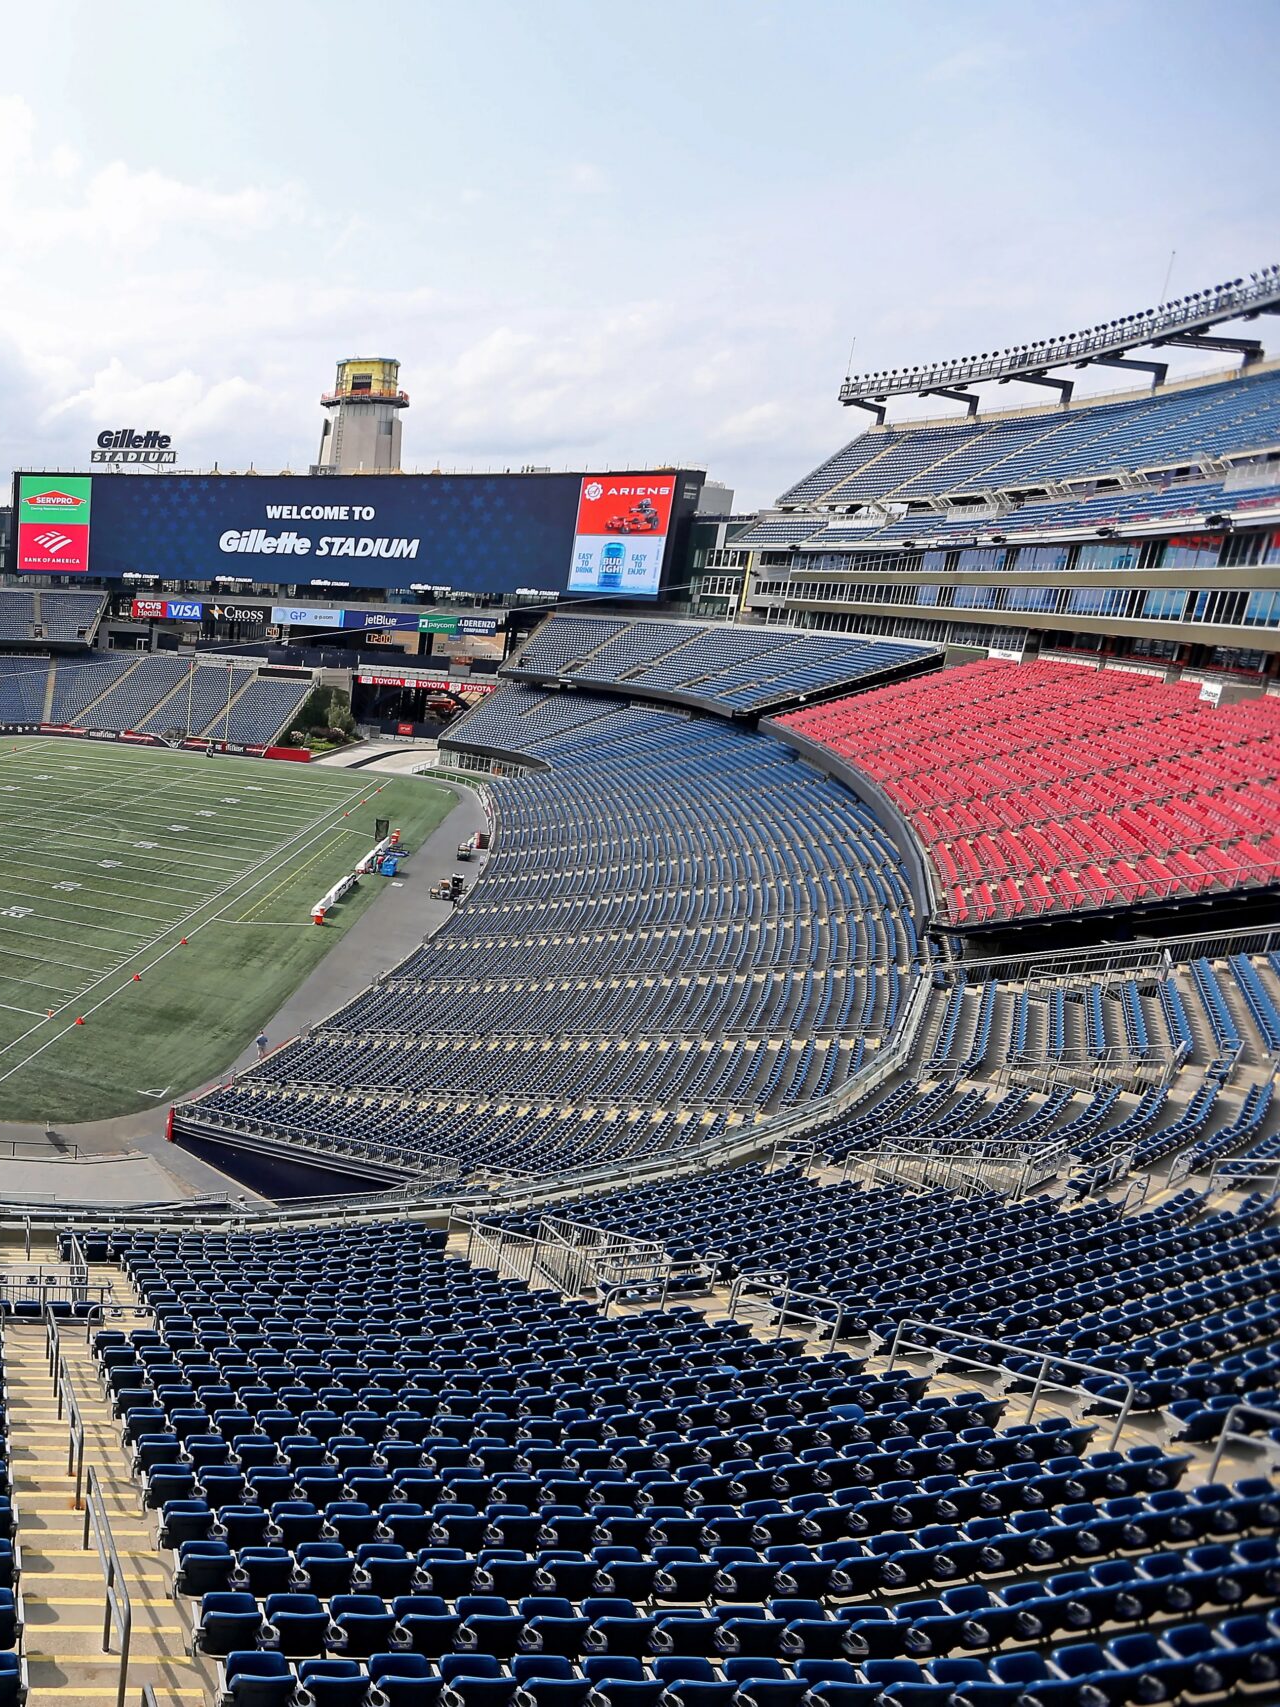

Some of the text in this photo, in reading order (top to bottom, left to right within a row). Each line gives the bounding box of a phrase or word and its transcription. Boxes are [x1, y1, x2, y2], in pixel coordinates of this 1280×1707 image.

[97, 429, 171, 448] Gillette
[92, 452, 175, 462] STADIUM
[607, 487, 670, 495] ARIENS
[266, 506, 375, 520] WELCOME TO
[219, 529, 420, 558] Gillette STADIUM
[578, 552, 594, 560] EASY
[628, 568, 647, 576] ENJOY
[145, 602, 162, 610] CVS
[168, 604, 200, 617] VISA
[364, 614, 396, 626] jetBlue
[370, 634, 392, 644] 12:00
[374, 678, 401, 686] TOYOTA
[418, 681, 446, 689] TOYOTA
[463, 684, 491, 692] TOYOTA
[0, 906, 34, 918] 20
